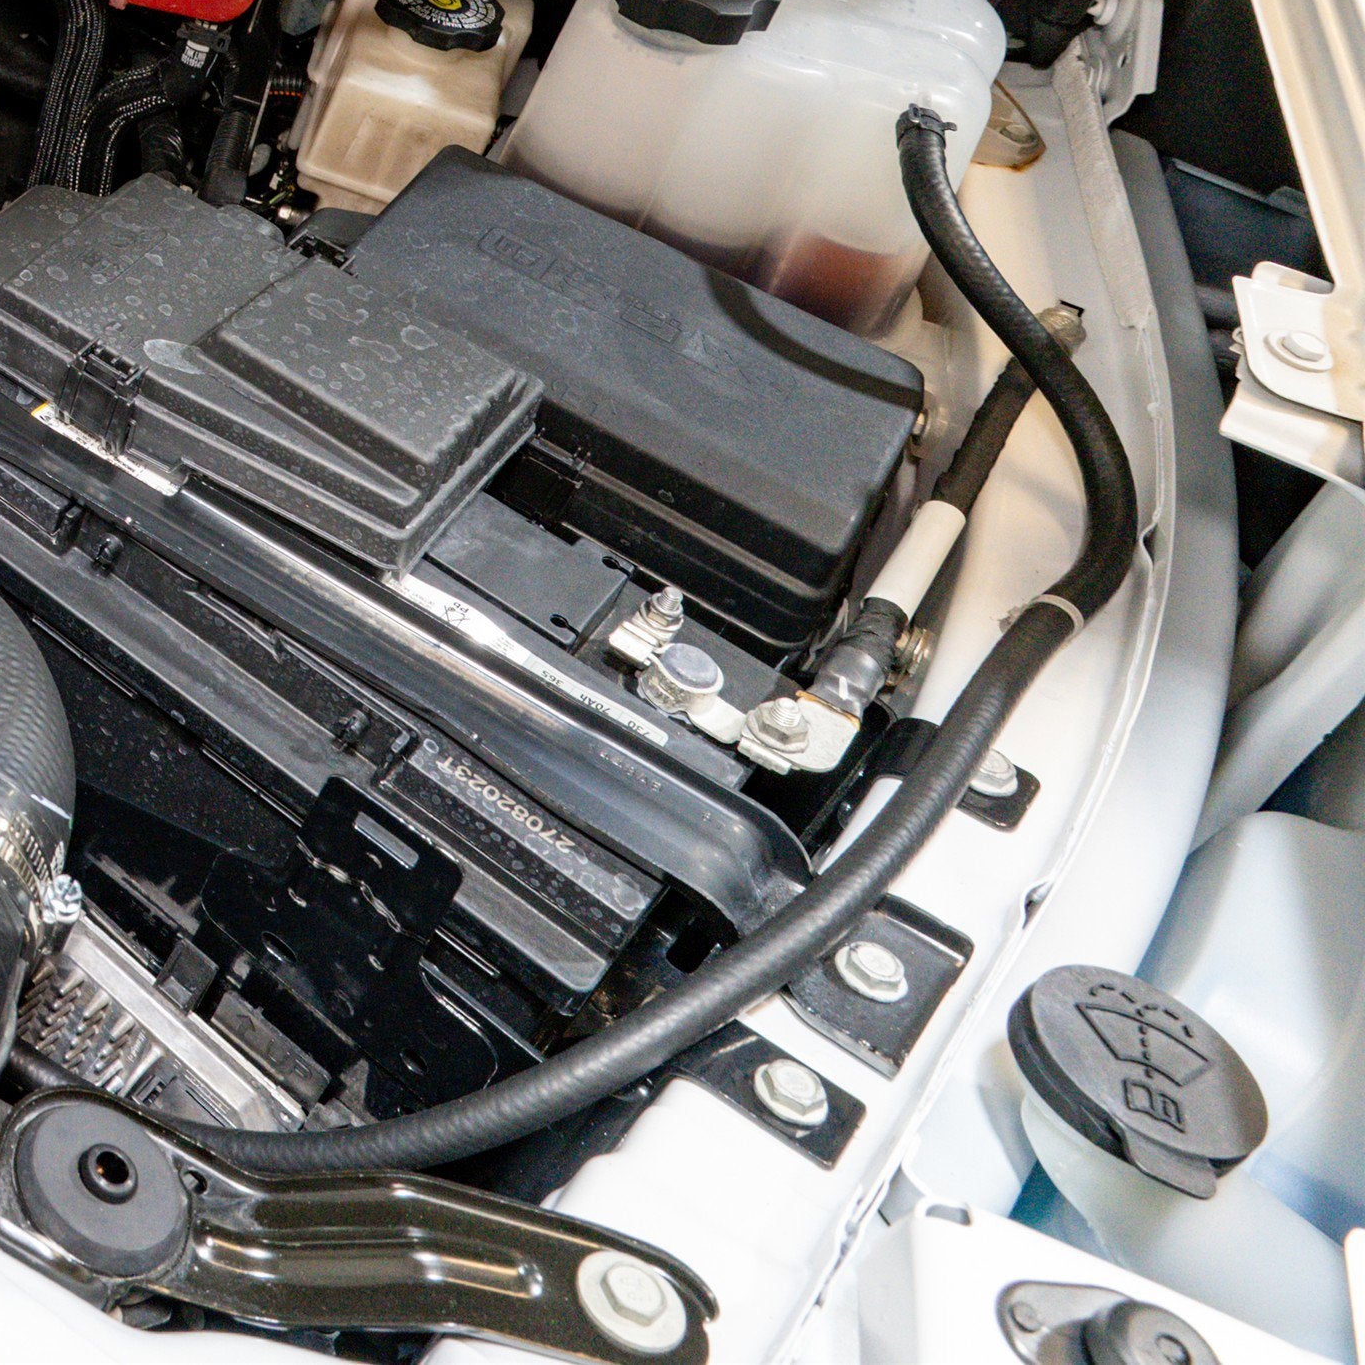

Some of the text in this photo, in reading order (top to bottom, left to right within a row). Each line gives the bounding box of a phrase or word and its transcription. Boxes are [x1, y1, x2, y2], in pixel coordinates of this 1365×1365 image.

[453, 601, 470, 614] Pb
[541, 669, 565, 687] 365
[579, 693, 611, 714] 70Ah
